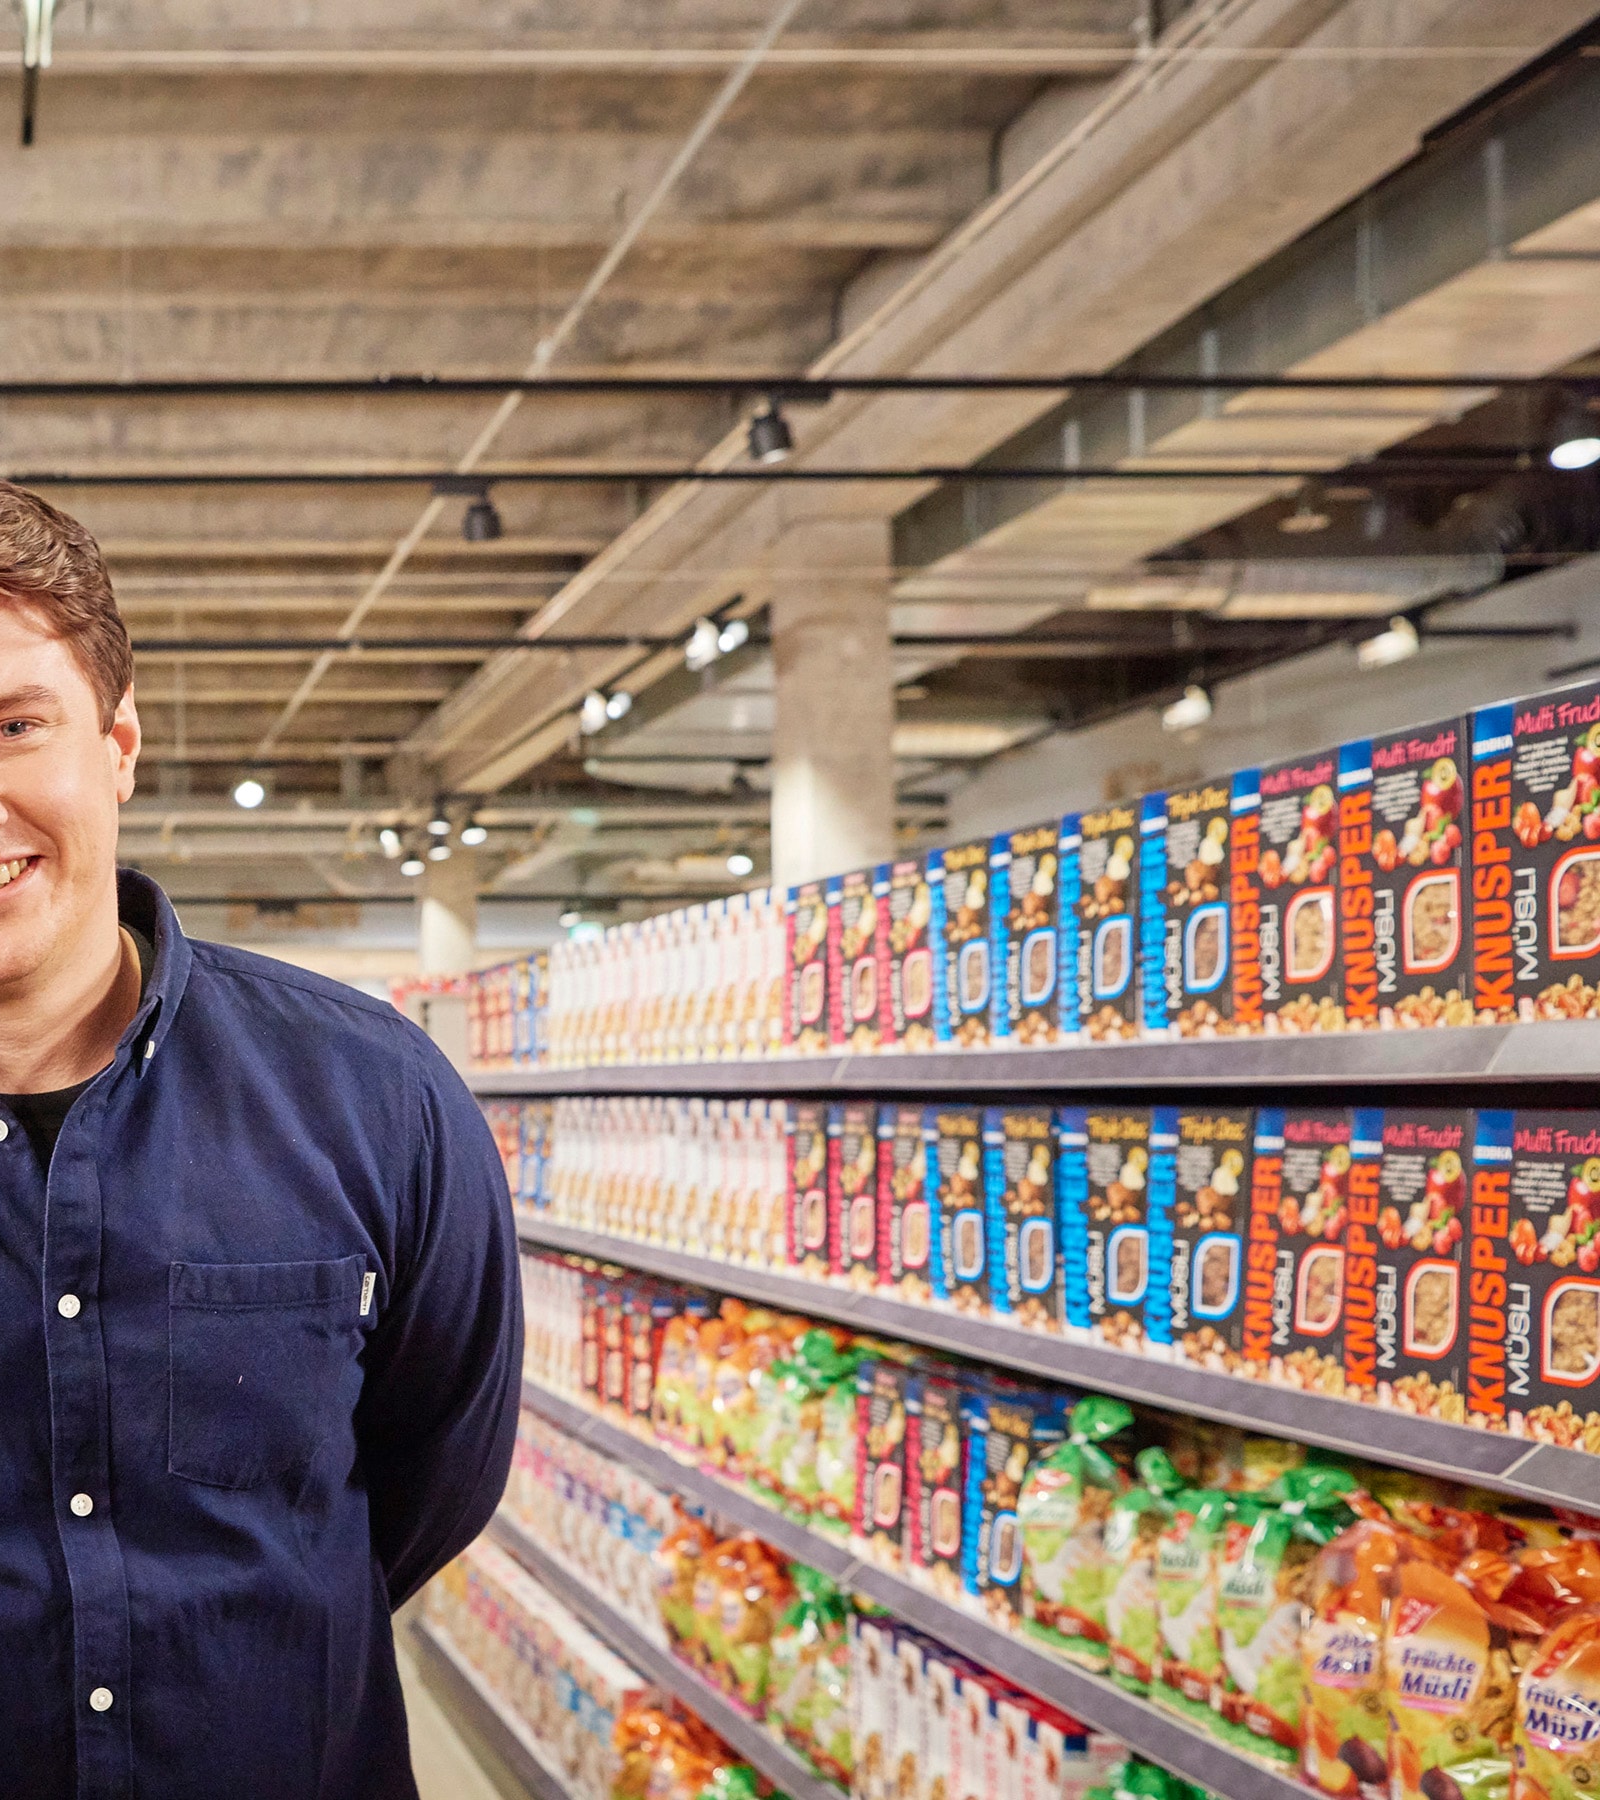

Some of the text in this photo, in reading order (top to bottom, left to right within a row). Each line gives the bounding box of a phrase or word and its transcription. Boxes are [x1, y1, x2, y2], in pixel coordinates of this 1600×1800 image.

[1513, 703, 1555, 737] Multi
[1139, 836, 1169, 1029] KNUSPER
[1230, 814, 1264, 1023] KNUSPER
[1338, 790, 1379, 1019] KNUSPER
[1374, 888, 1398, 993] MÜSLI
[1471, 759, 1515, 1010] KNUSPER
[1513, 867, 1539, 980] MÜSLI
[1259, 904, 1282, 1000] MÜSLI
[1513, 1127, 1554, 1154] Multi
[1143, 1153, 1177, 1345] KNUSPER
[1242, 1156, 1284, 1361] KNUSPER
[1271, 1250, 1295, 1346] MÜSLI
[1344, 1163, 1381, 1388] KNUSPER
[1467, 1170, 1511, 1418] KNUSPER
[1375, 1264, 1398, 1369] MÜSLI
[1507, 1282, 1531, 1396] MÜSLI
[1401, 1647, 1477, 1675] Früchte
[1401, 1671, 1472, 1701] Müsli
